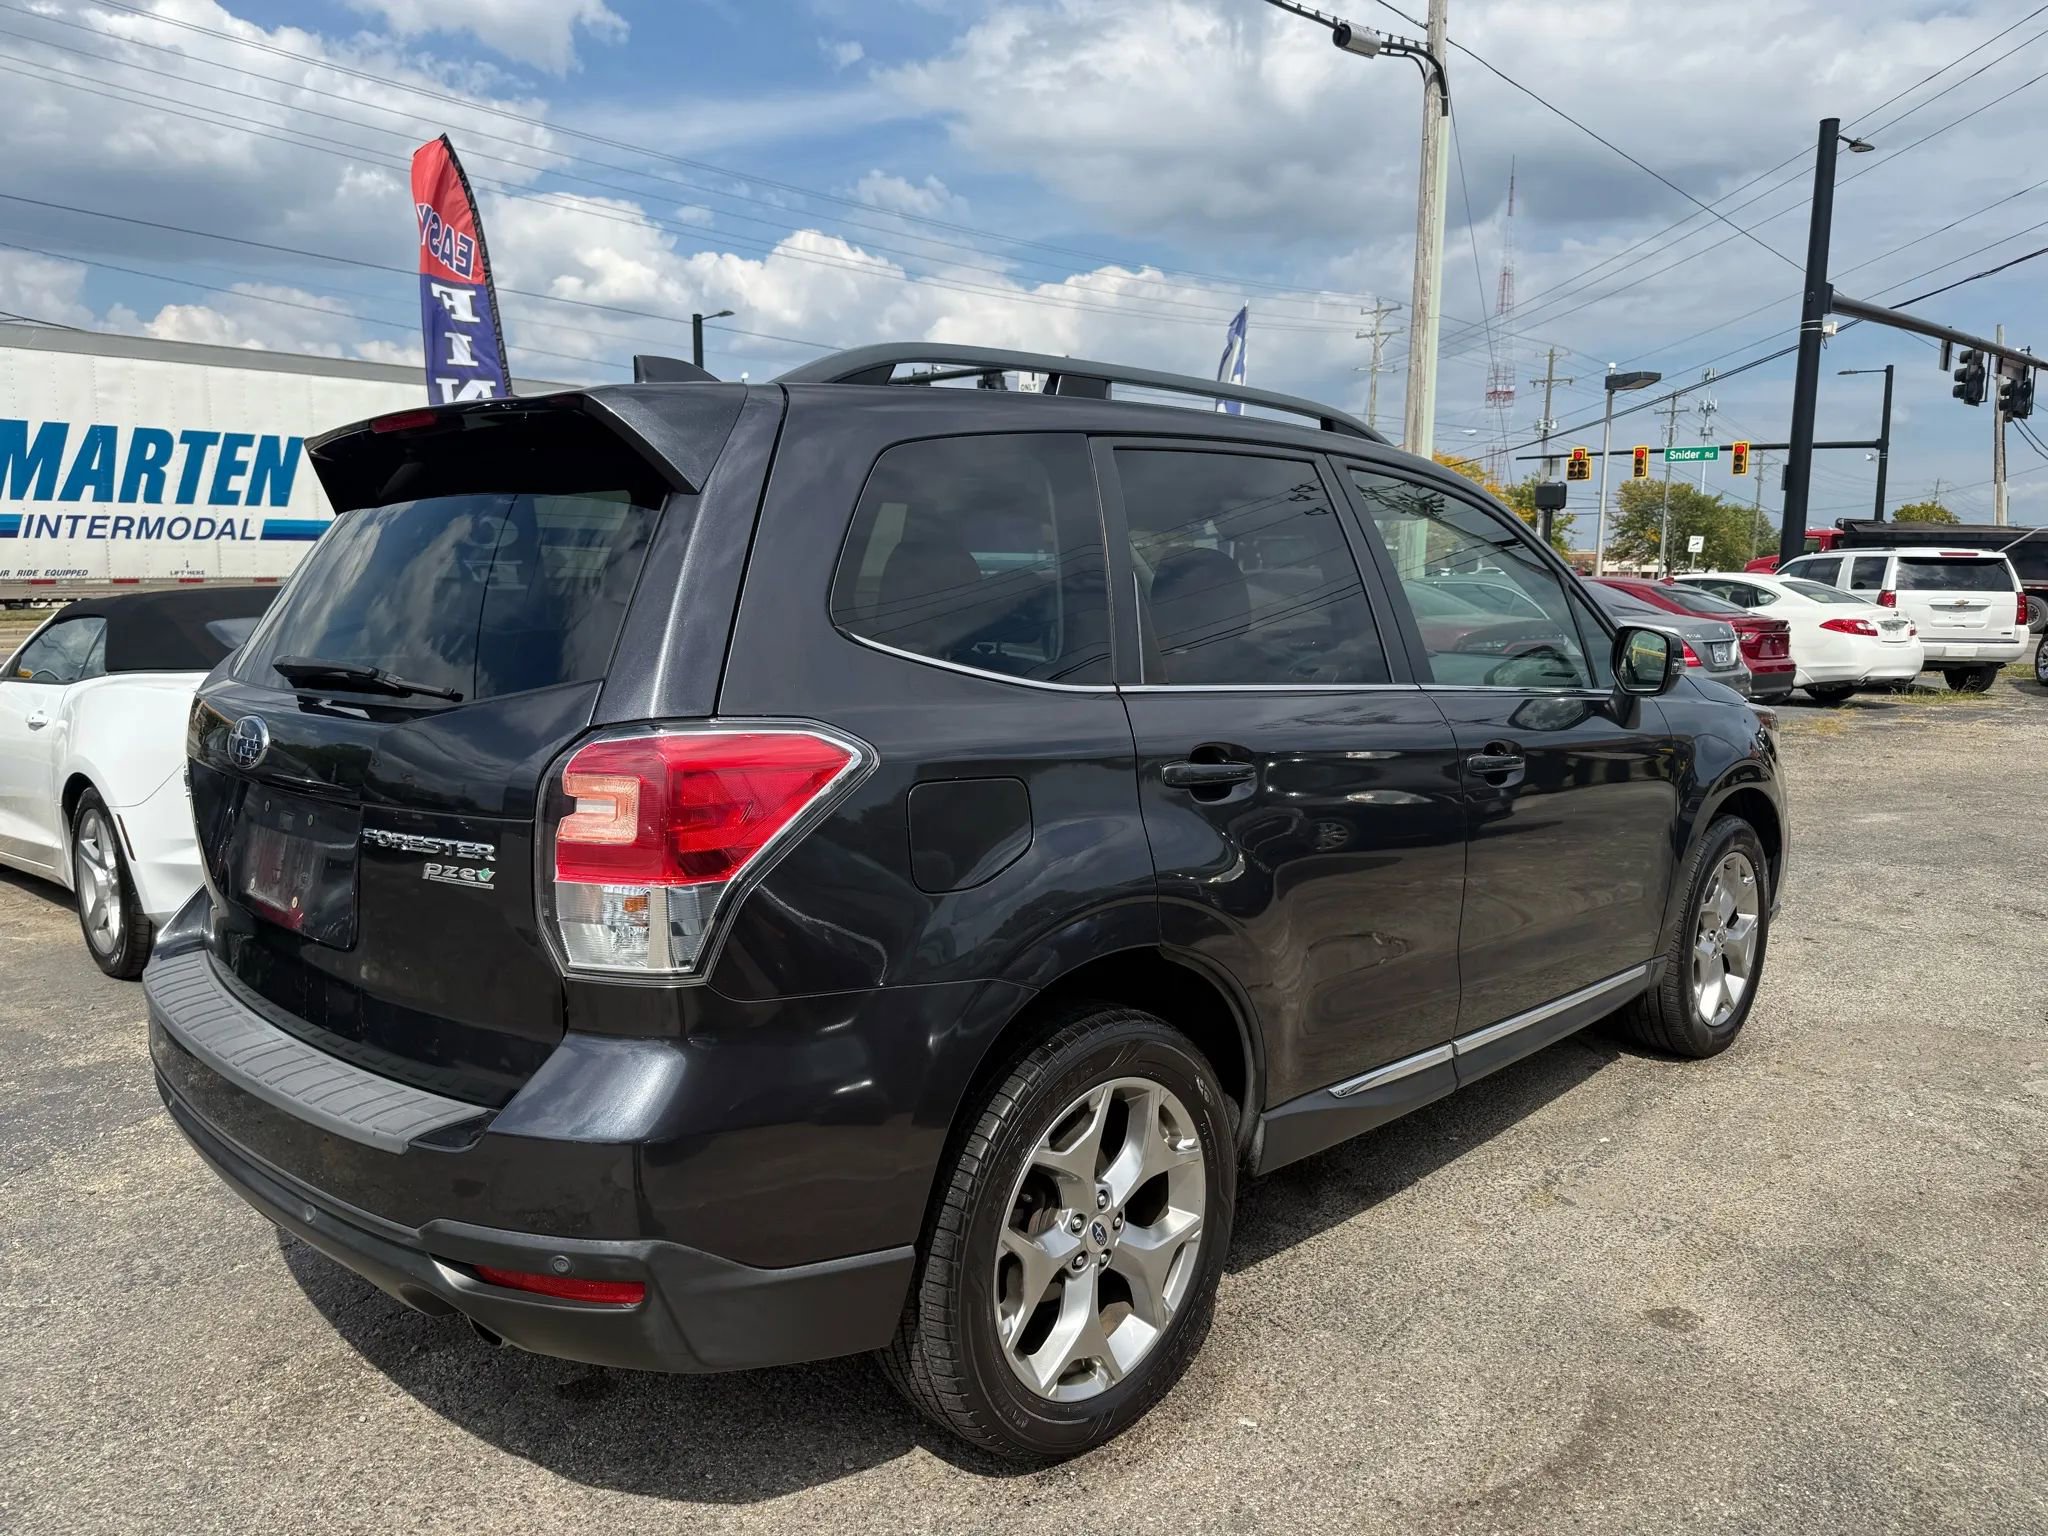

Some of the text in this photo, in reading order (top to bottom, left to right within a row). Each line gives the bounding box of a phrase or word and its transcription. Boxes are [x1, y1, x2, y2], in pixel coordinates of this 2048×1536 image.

[1020, 383, 1037, 391] ONLY
[0, 419, 304, 507] MARTEN
[1669, 450, 1714, 460] Snider Rd
[23, 514, 257, 541] INTERMODAL
[16, 569, 40, 577] RIDE
[44, 569, 89, 577] EQUIPPED
[362, 828, 496, 862] FORESTER
